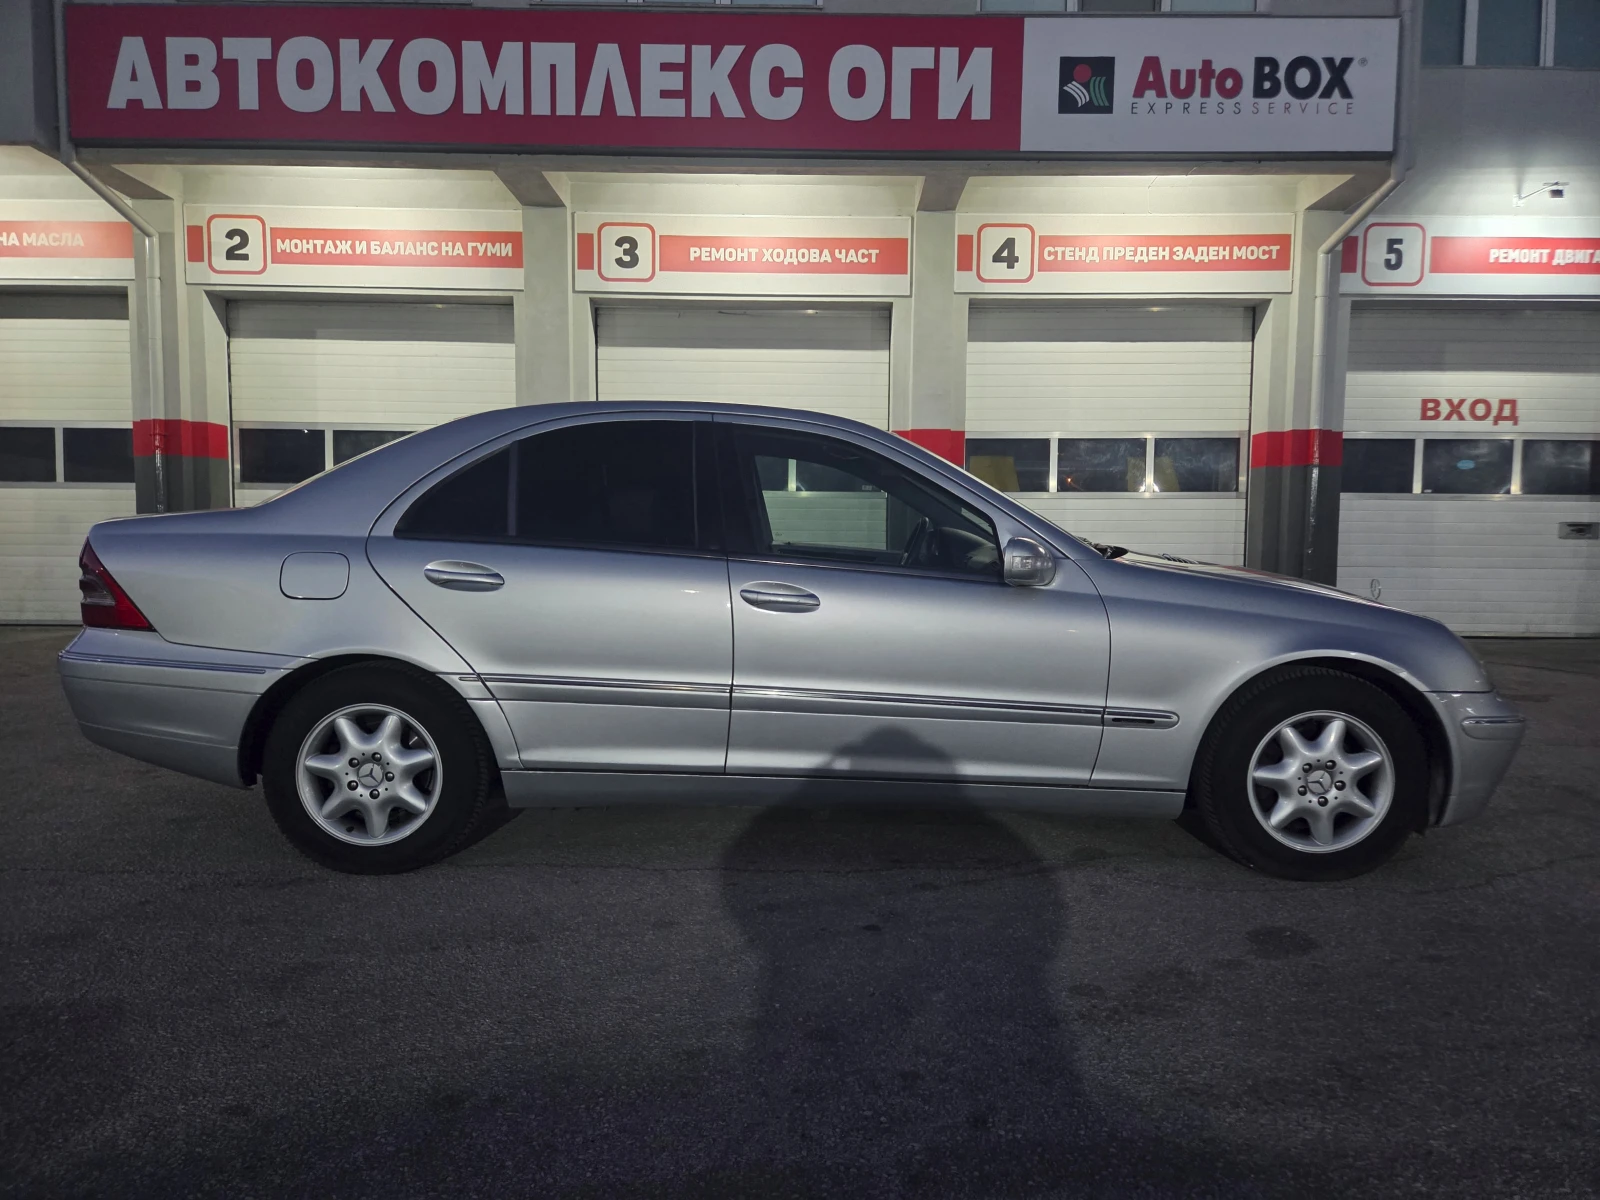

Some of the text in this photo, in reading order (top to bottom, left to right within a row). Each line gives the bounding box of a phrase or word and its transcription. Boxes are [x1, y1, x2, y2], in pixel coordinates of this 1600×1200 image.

[106, 36, 993, 122] АВТОКОМПЛЕКС ОГИ
[1132, 56, 1244, 100] Auto
[22, 232, 85, 247] МАСЛА
[225, 228, 250, 261] 2
[276, 238, 513, 257] МОНТАЖ И БАЛАНС НА ГУМИ
[614, 236, 640, 269] 3
[991, 237, 1020, 269] 4
[1043, 245, 1280, 263] СТЕНД ПРЕДЕН ЗАДЕН МОСТ
[1384, 238, 1404, 270] 5
[689, 247, 880, 265] РЕМОНТ ХОДОВА ЧАСТ
[1489, 248, 1550, 264] РЕМОНТ
[1420, 398, 1519, 426] ВХОД
